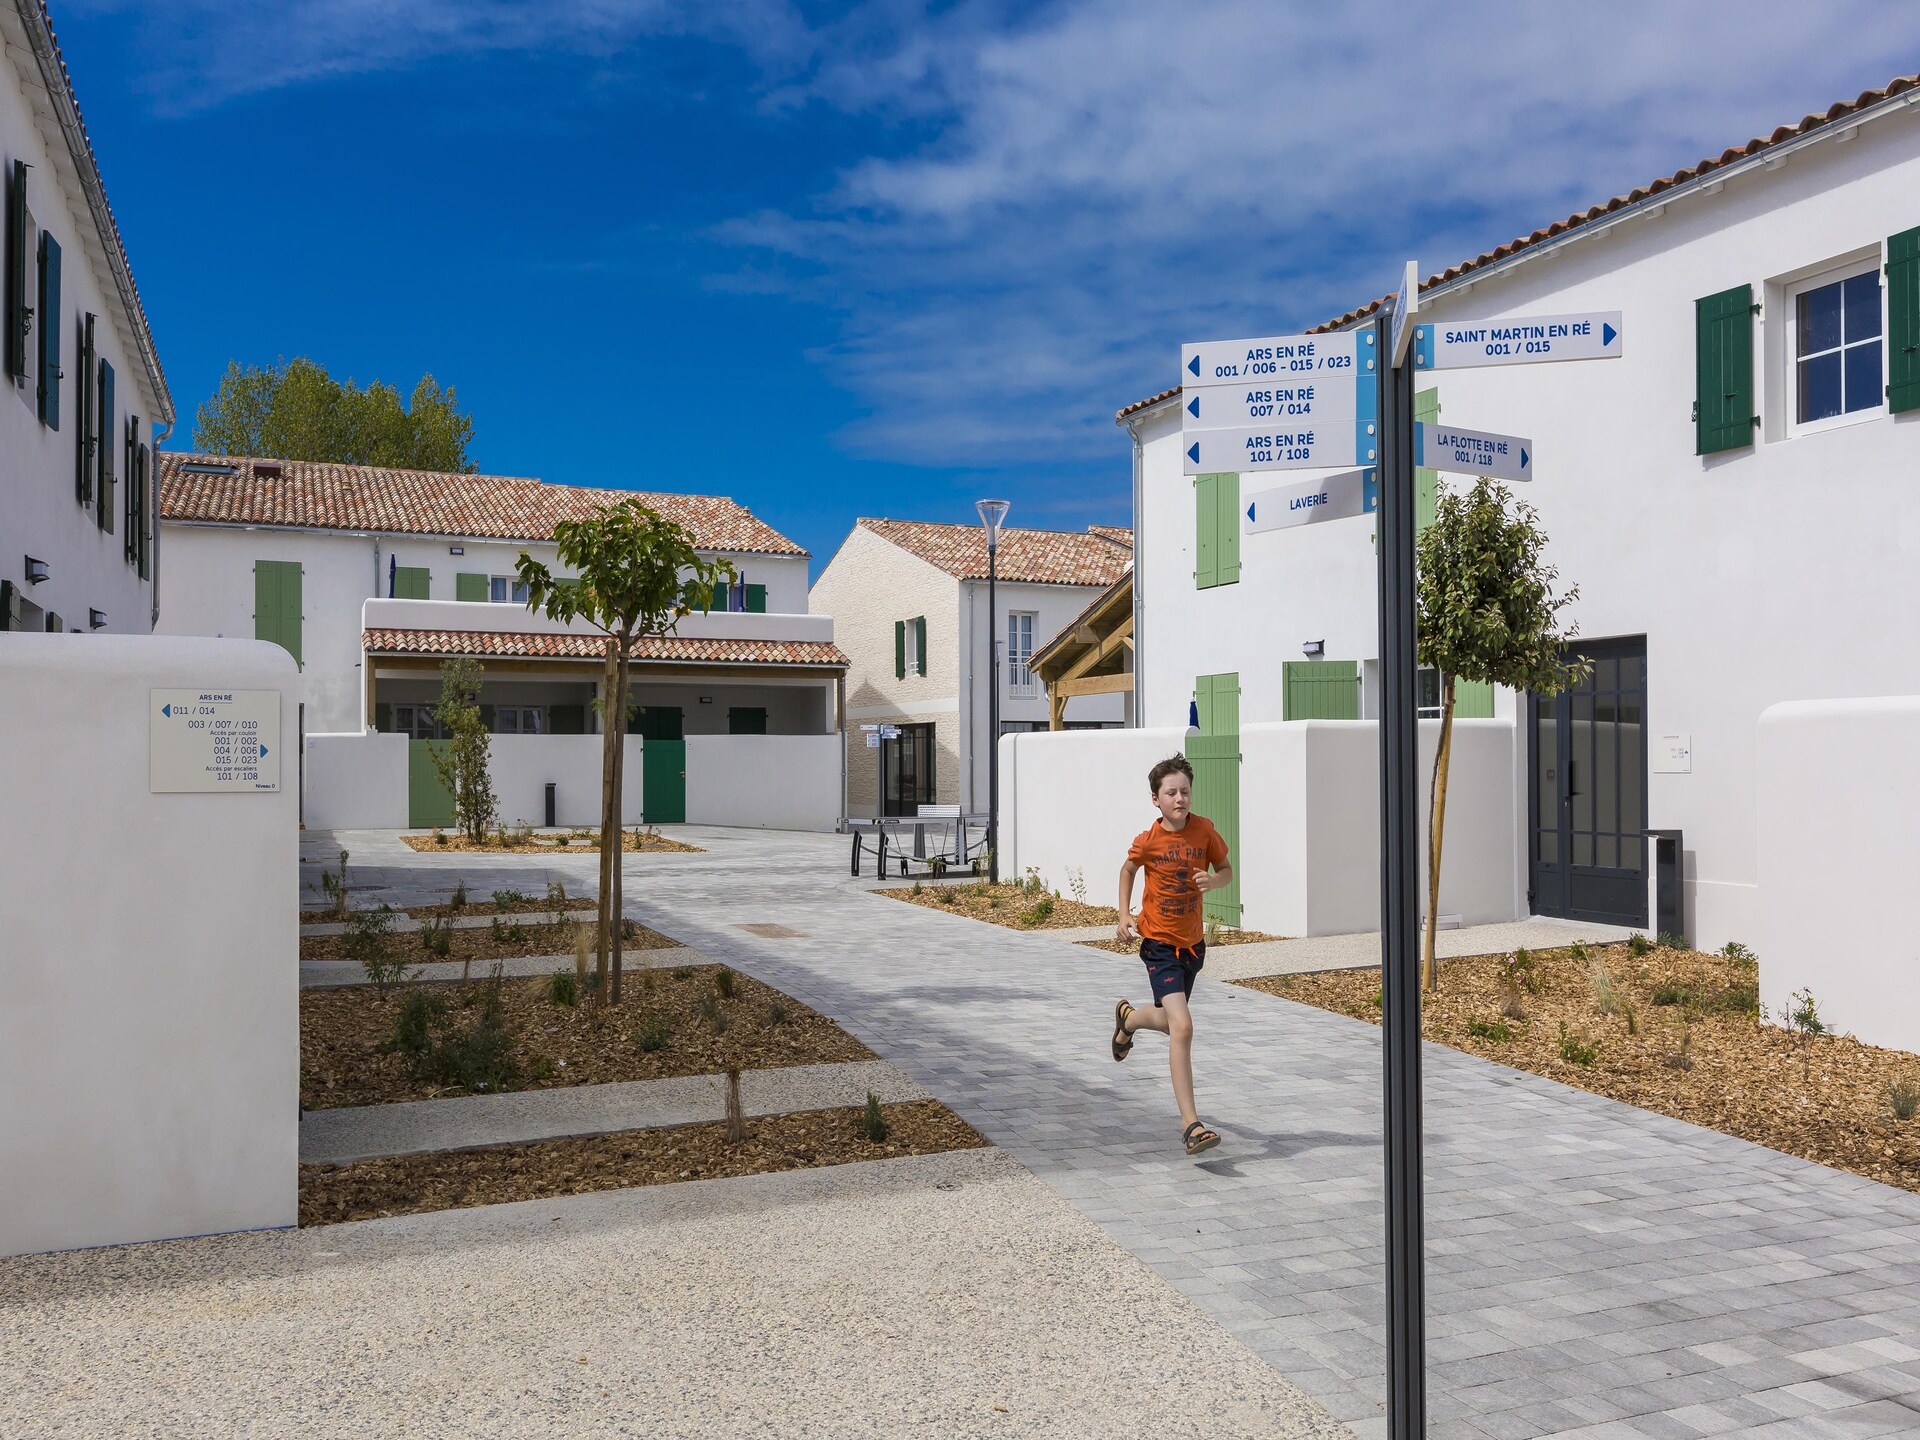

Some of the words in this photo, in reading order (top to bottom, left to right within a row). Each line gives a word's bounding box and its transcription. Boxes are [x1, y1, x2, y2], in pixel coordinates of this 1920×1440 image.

[1445, 329, 1487, 344] SAINT
[1491, 326, 1545, 341] MARTIN
[1549, 324, 1568, 337] EN
[1572, 320, 1591, 336] RÉ
[1246, 348, 1273, 361] ARS
[1276, 346, 1294, 359] EN
[1298, 342, 1315, 357] RÉ
[1485, 343, 1511, 356] 001
[1515, 342, 1522, 354] /
[1525, 340, 1551, 354] 015
[1215, 365, 1239, 378] 001
[1243, 364, 1249, 376] /
[1252, 361, 1277, 375] 006
[1290, 359, 1314, 372] 015
[1318, 357, 1324, 370] /
[1327, 355, 1351, 369] 023
[1245, 391, 1272, 404] ARS
[1276, 389, 1294, 402] EN
[1298, 386, 1315, 401] RÉ
[1250, 404, 1274, 418] 007
[1278, 404, 1284, 416] /
[1287, 402, 1311, 415] 014
[1245, 436, 1272, 449] ARS
[1275, 434, 1294, 447] EN
[1297, 430, 1315, 446] RÉ
[1437, 433, 1449, 447] LA
[1450, 435, 1482, 451] FLOTTE
[1484, 440, 1496, 453] EN
[1497, 441, 1508, 455] RÉ
[1250, 450, 1273, 463] 101
[1277, 449, 1283, 461] /
[1286, 448, 1310, 461] 108
[1454, 450, 1471, 463] 001
[1472, 453, 1477, 464] /
[1478, 454, 1493, 466] 118
[1290, 493, 1328, 511] LAVERIE
[223, 693, 233, 701] RÉ
[172, 706, 189, 715] 011
[191, 706, 197, 715] /
[198, 706, 215, 715] 014
[187, 720, 205, 729] 003
[207, 720, 213, 729] /
[214, 720, 232, 729] 007
[234, 720, 239, 729] /
[241, 720, 258, 729] 010
[214, 736, 231, 745] 001
[233, 736, 239, 745] /
[240, 736, 258, 745] 002
[213, 746, 231, 755] 004
[233, 746, 239, 755] /
[240, 746, 258, 755] 006
[215, 755, 232, 764] 015
[234, 756, 239, 764] /
[241, 756, 258, 764] 023
[216, 772, 233, 781] 101
[235, 772, 240, 781] /
[242, 772, 259, 781] 108
[1151, 849, 1181, 868] SHARK
